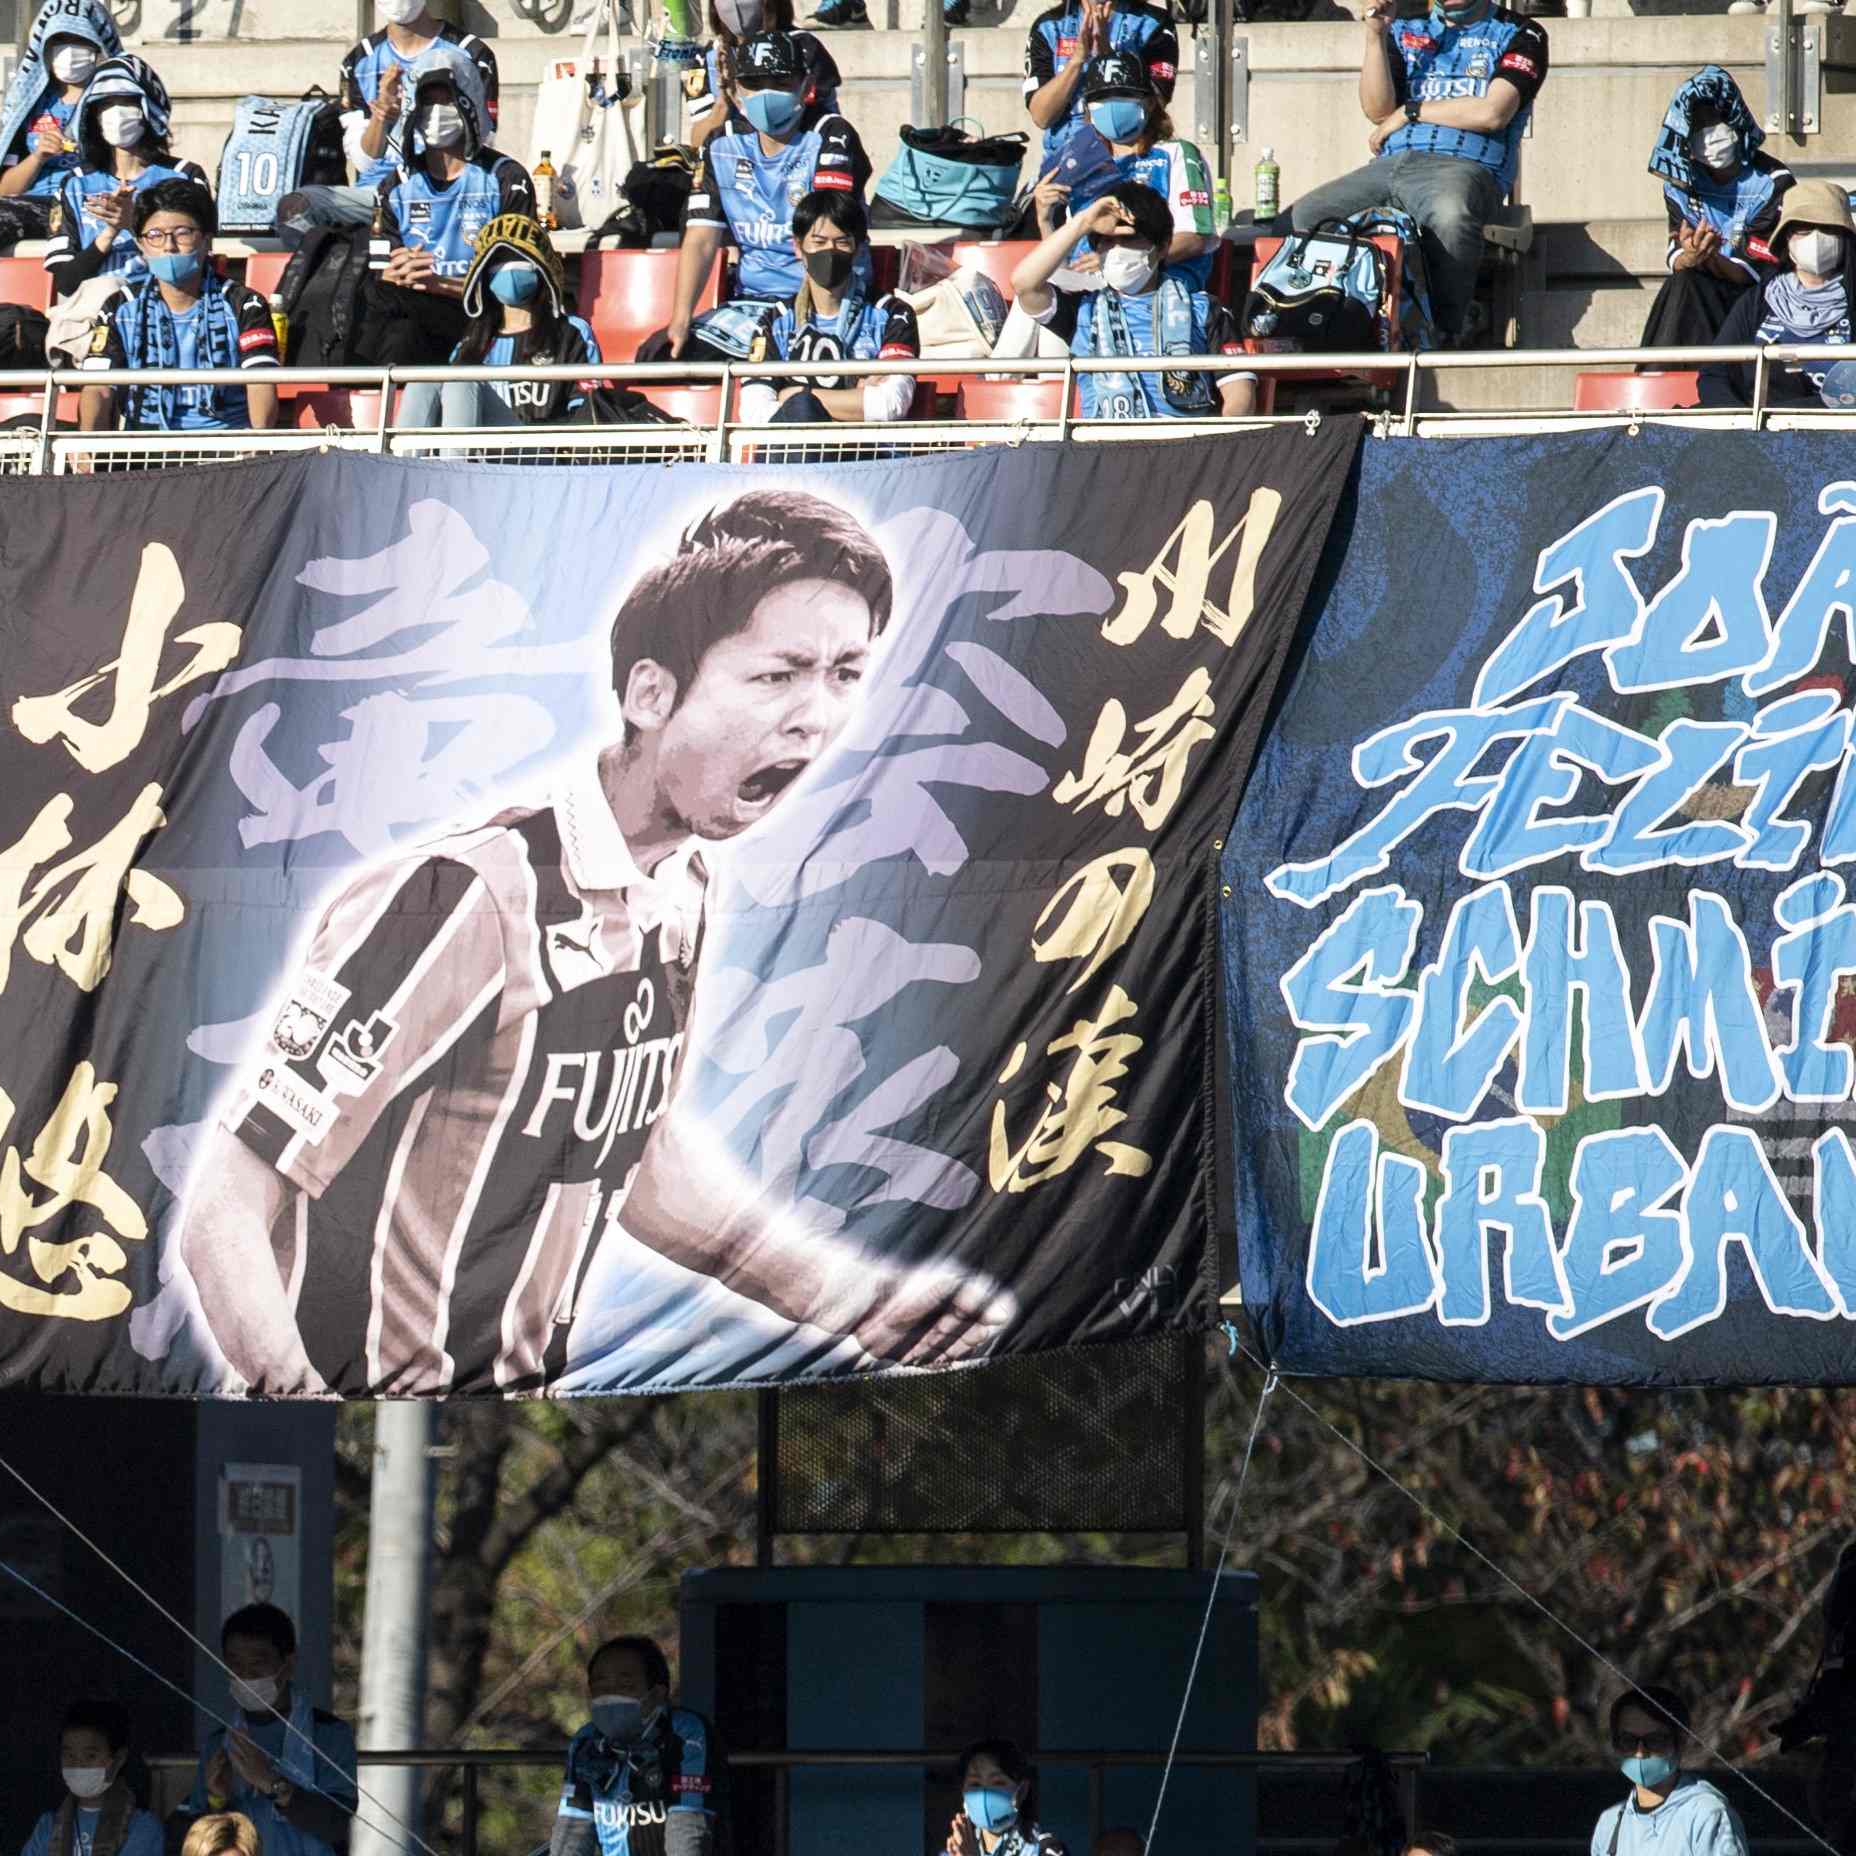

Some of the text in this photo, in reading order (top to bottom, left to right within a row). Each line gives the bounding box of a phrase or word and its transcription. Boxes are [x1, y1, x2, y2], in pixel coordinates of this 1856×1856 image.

[235, 151, 278, 196] 10
[734, 218, 796, 249] FUJITS
[1100, 394, 1131, 419] 18
[987, 485, 1282, 1195] 川崎の漢
[1264, 688, 1856, 906] FELI
[521, 1032, 686, 1170] FUJITS
